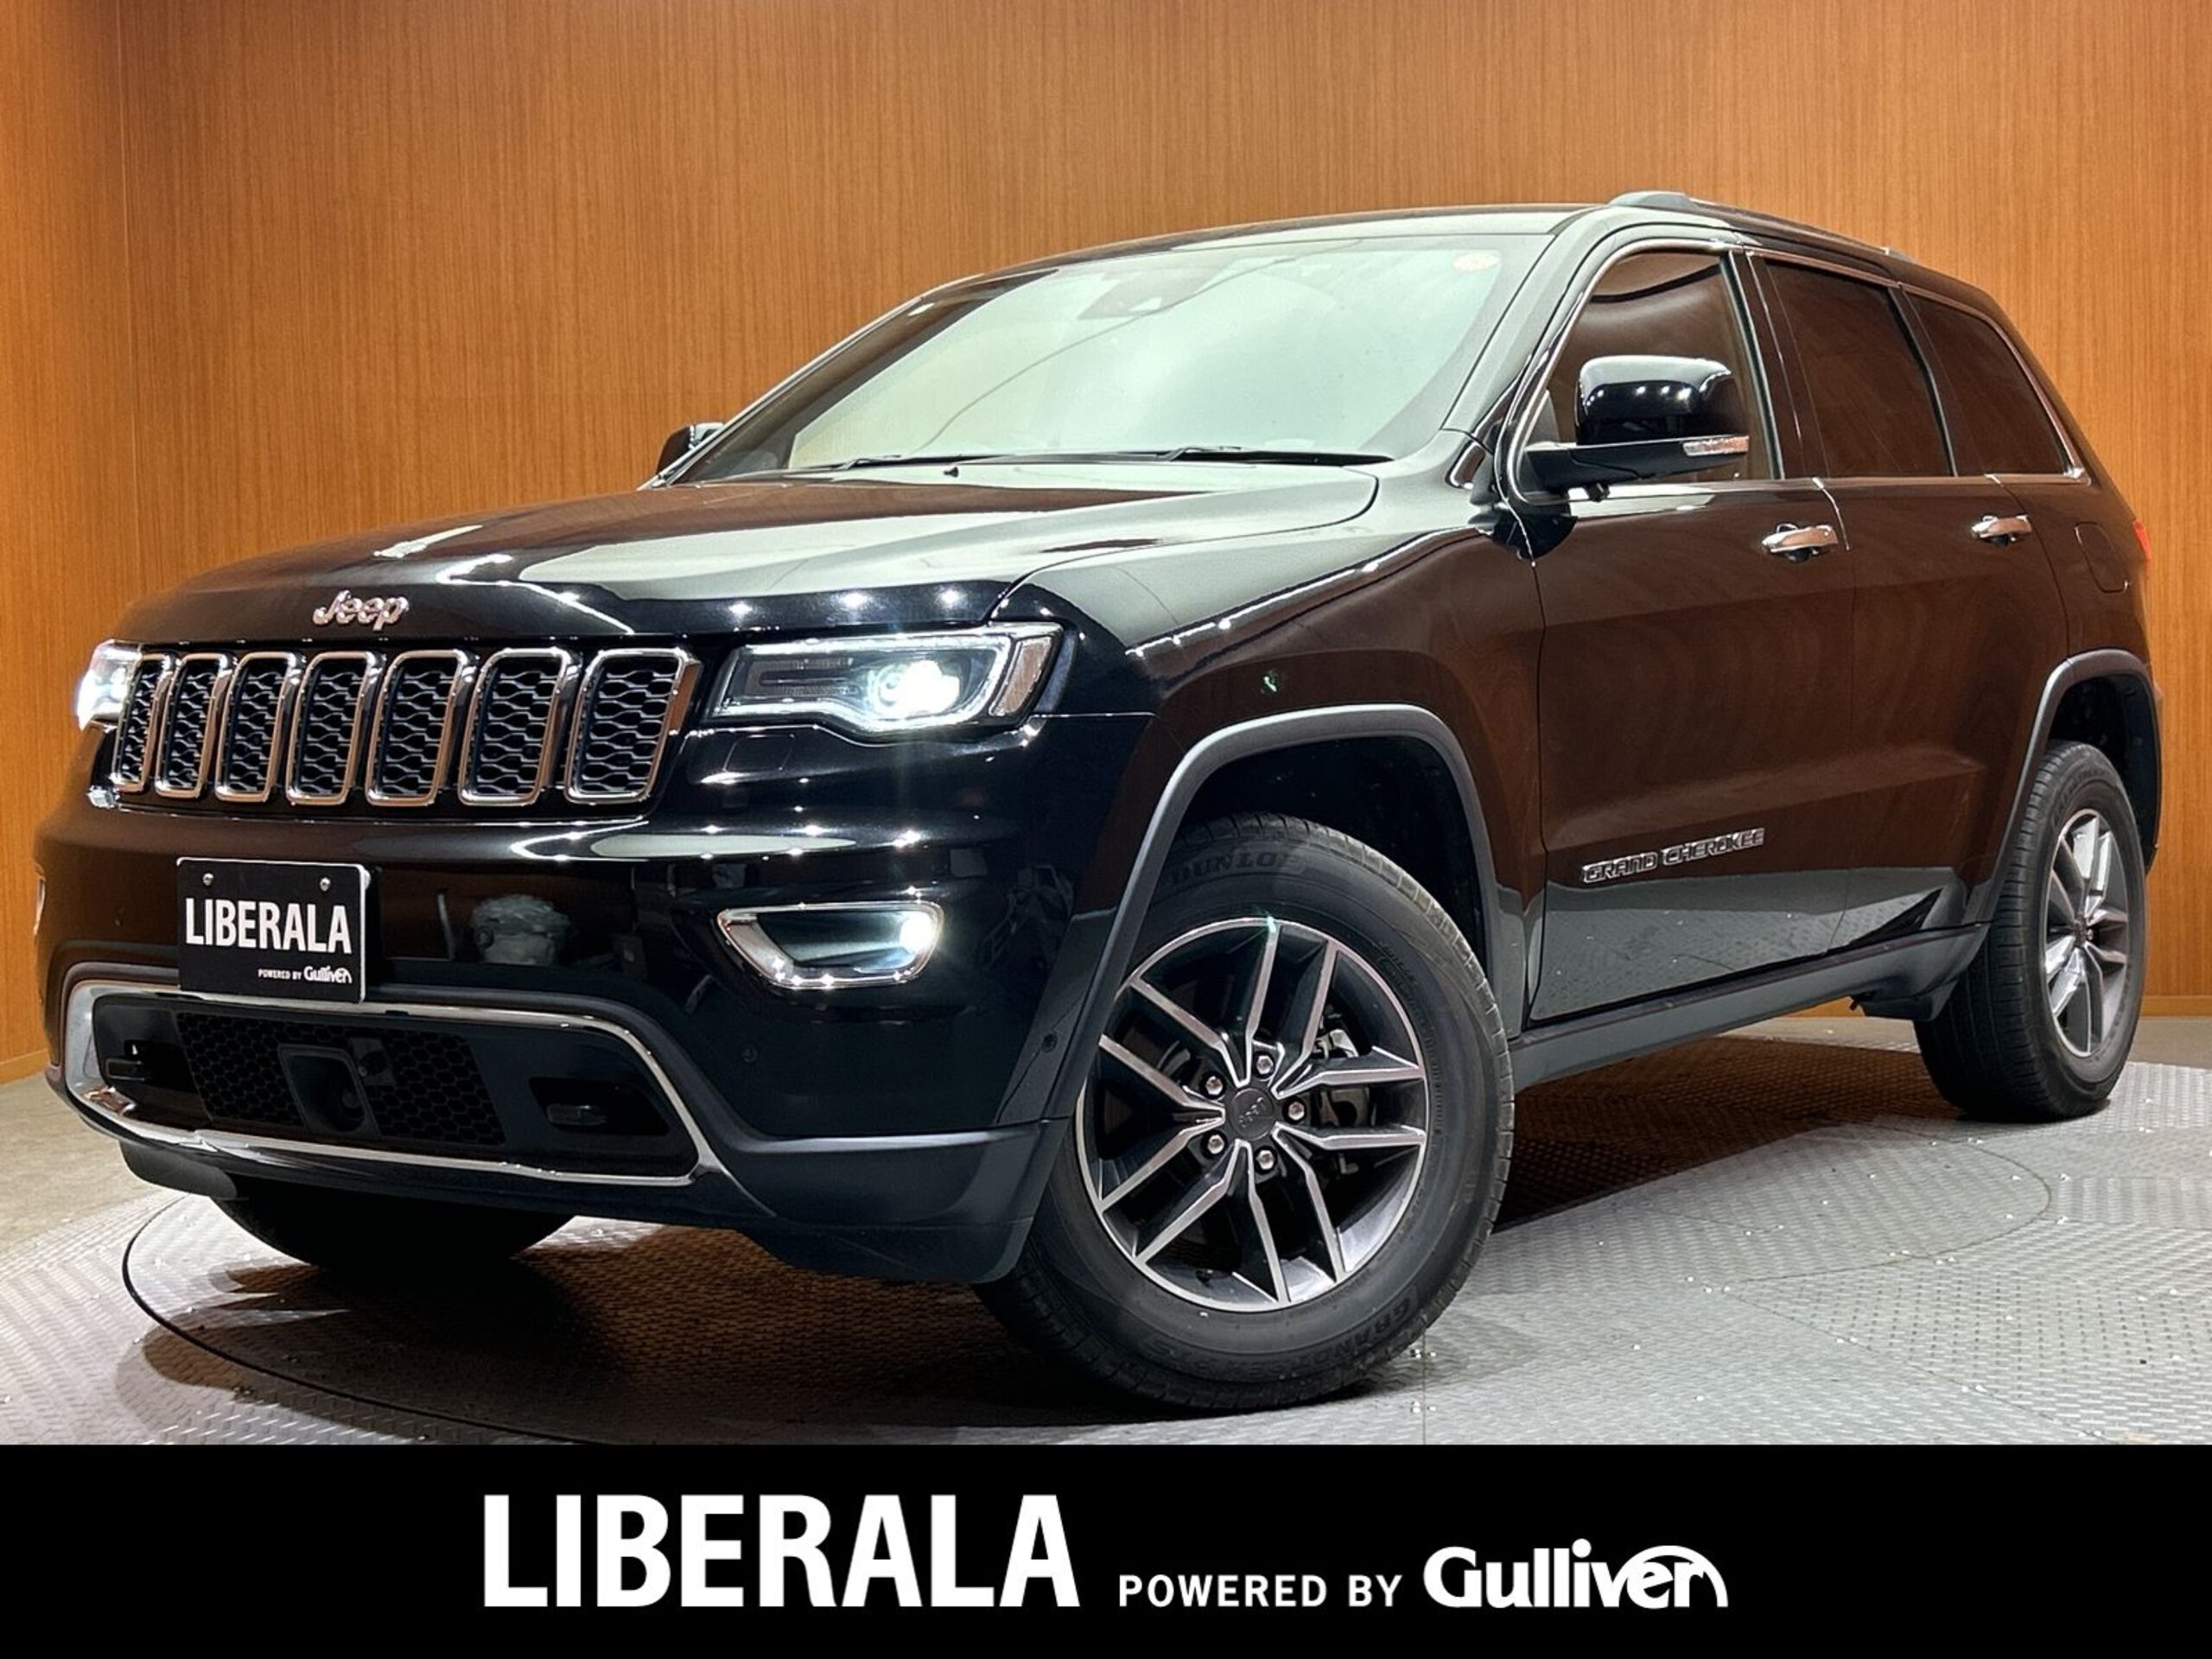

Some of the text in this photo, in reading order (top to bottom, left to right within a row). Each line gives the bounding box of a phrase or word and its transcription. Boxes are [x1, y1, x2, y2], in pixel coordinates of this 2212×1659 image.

[313, 589, 410, 631] Jeep
[1582, 827, 1765, 883] GRAND CHEROKEE
[186, 898, 352, 954] LIBERALA
[257, 965, 353, 984] POWERED BY Gulliver
